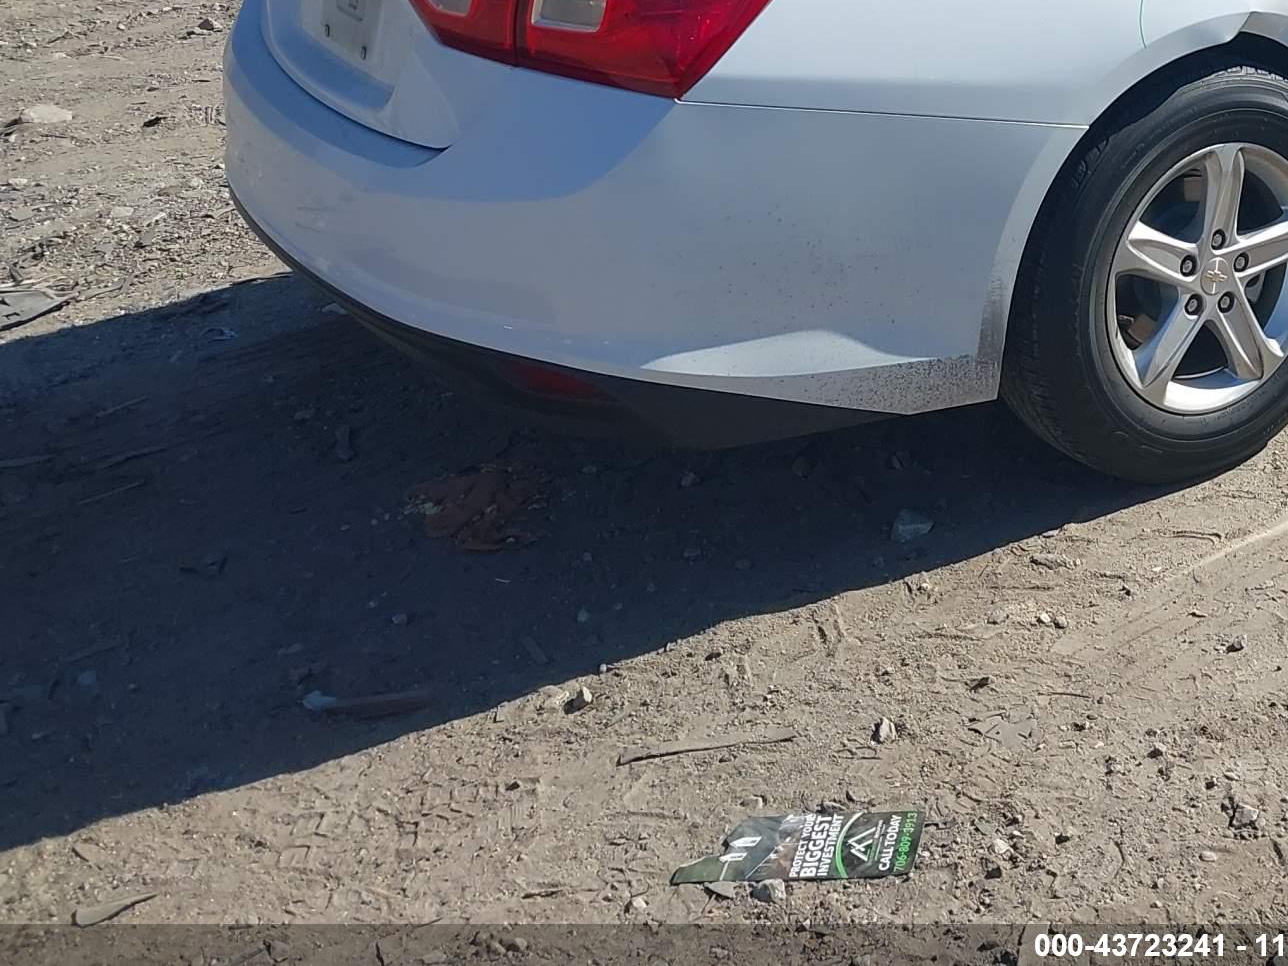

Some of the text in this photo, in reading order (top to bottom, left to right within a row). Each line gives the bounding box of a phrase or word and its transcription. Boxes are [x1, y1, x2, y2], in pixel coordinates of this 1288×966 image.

[800, 815, 832, 877] BIGGEST
[817, 814, 844, 876] INVESTMENT
[884, 815, 902, 849] TODAY
[893, 812, 917, 873] 706-809-3913
[789, 841, 807, 877] PROTECT
[879, 847, 894, 870] CALL
